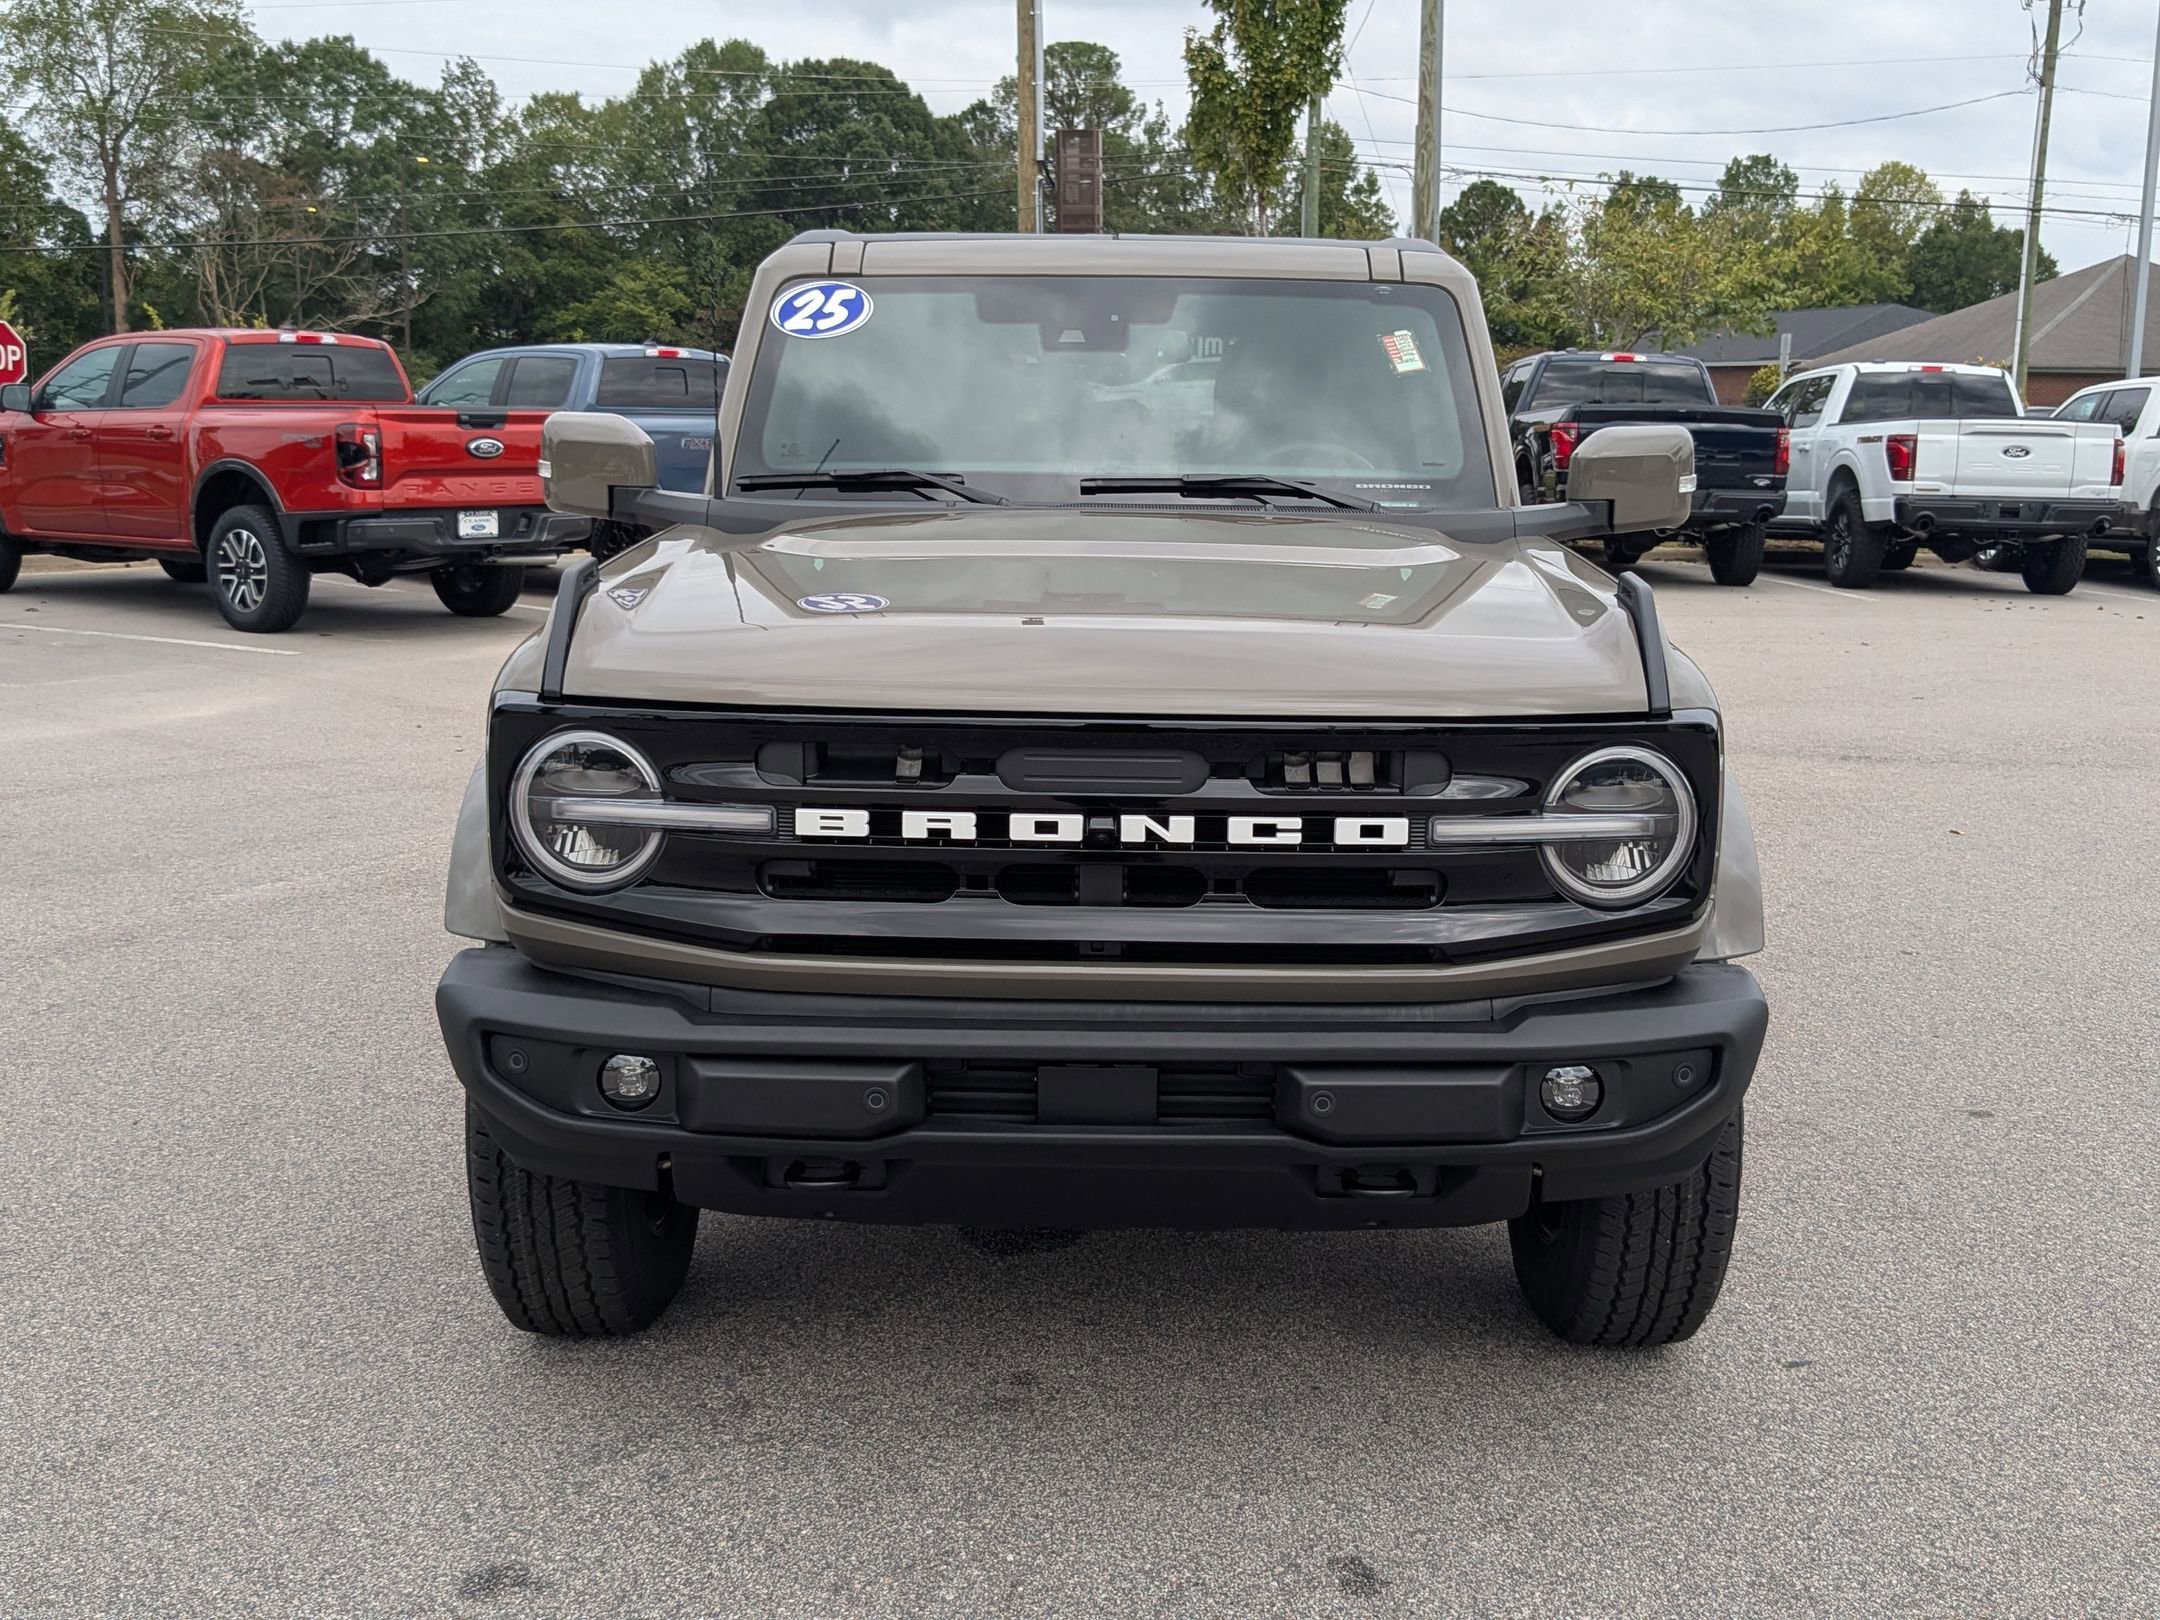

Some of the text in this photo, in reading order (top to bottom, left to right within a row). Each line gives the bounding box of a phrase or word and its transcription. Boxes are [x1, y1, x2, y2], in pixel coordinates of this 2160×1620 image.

[783, 289, 857, 330] 25
[401, 480, 536, 497] RANGE
[794, 808, 1410, 846] BRONCO
